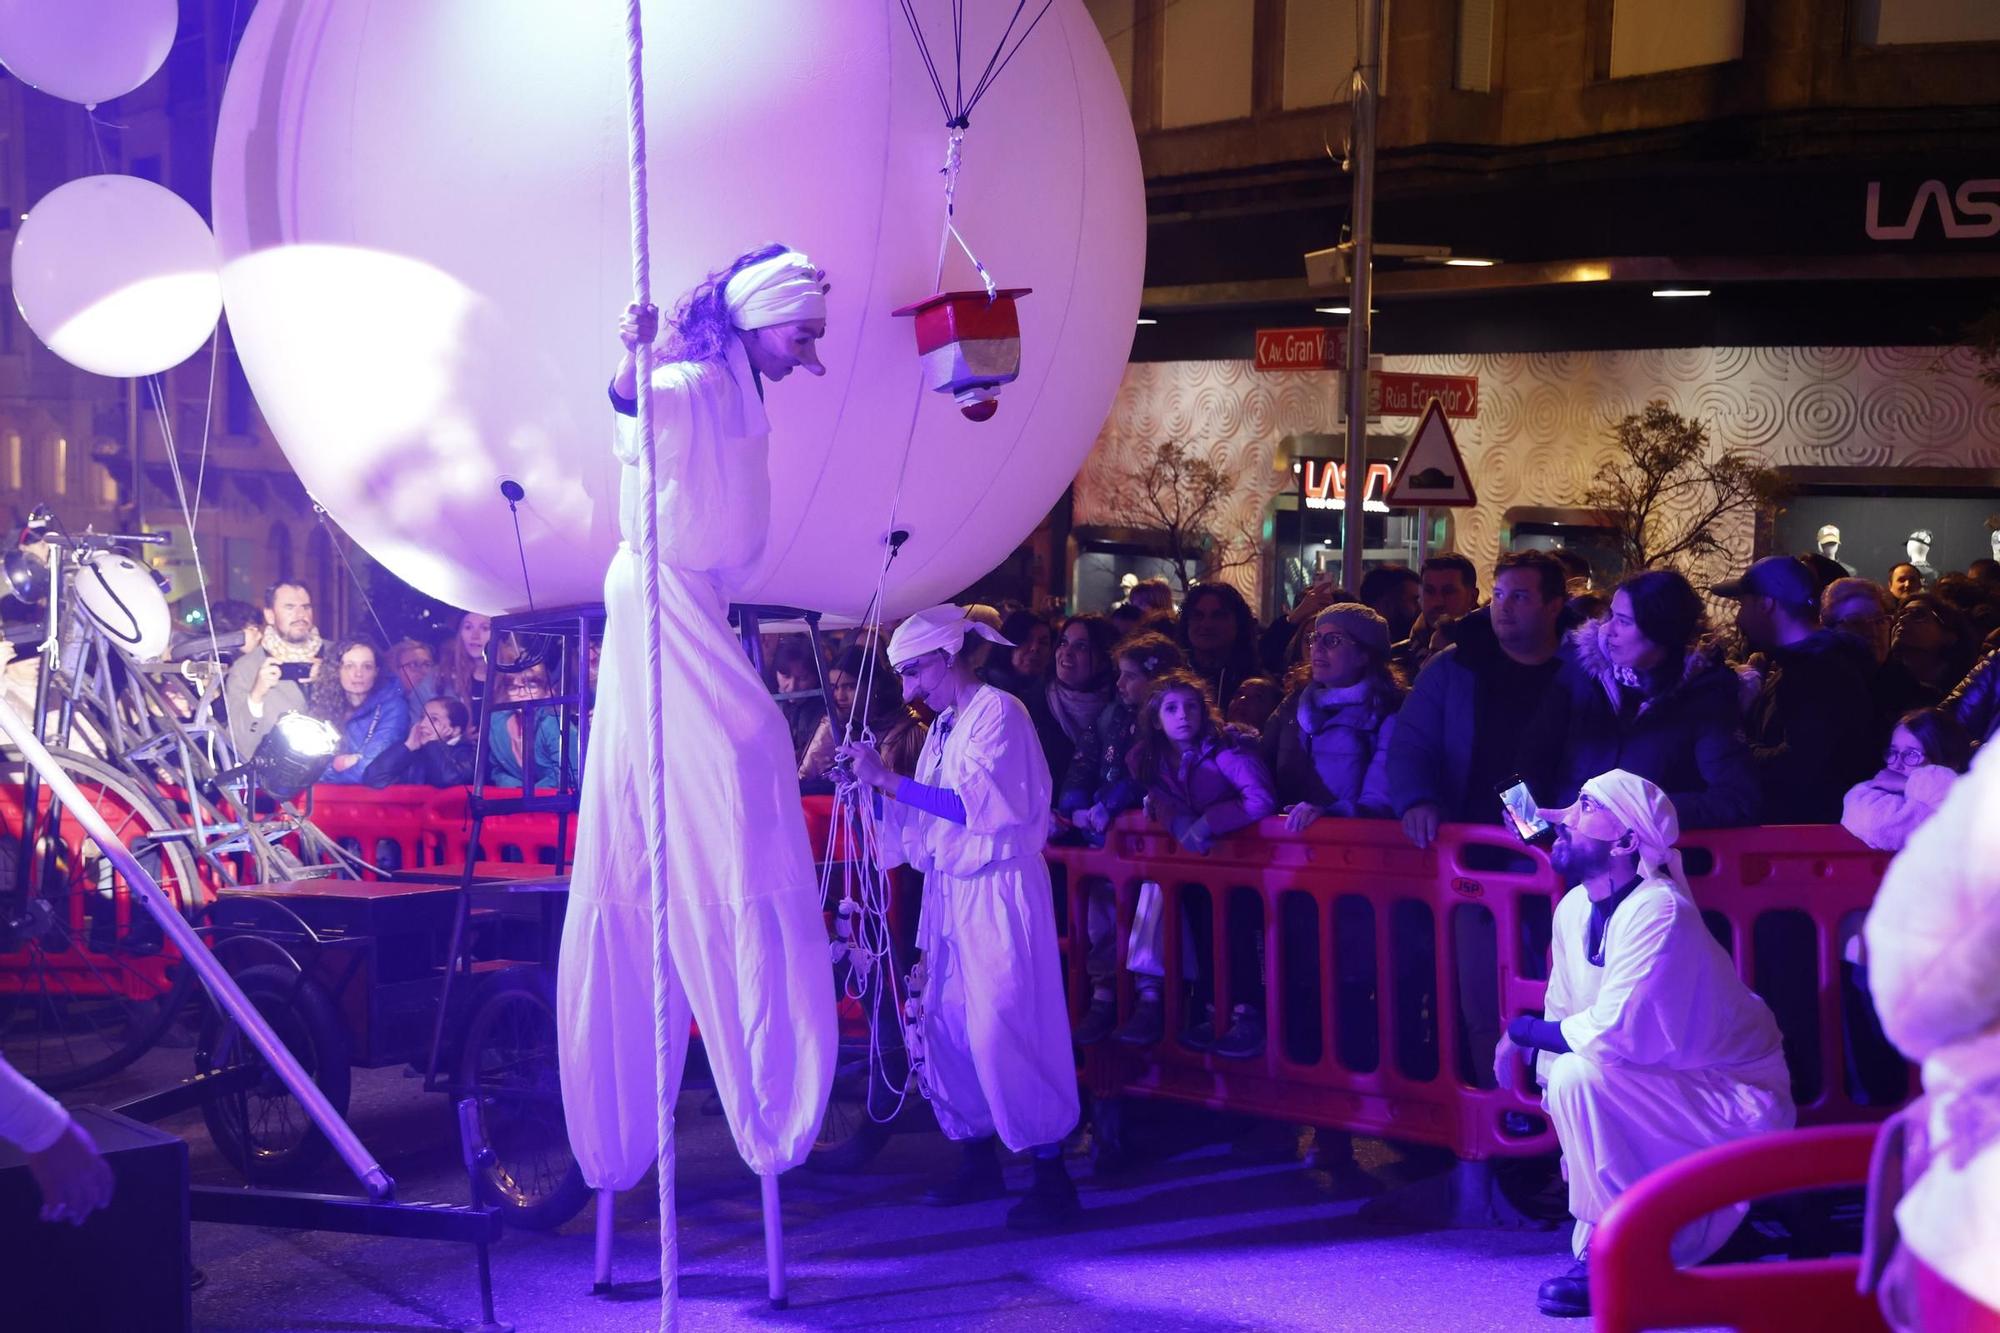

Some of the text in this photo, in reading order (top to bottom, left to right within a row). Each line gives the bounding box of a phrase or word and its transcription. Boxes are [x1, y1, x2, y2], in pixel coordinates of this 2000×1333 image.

[1268, 343, 1282, 362] Av.
[1285, 335, 1313, 362] Gran
[1386, 385, 1407, 409] Rúa
[1456, 879, 1480, 894] JSP
